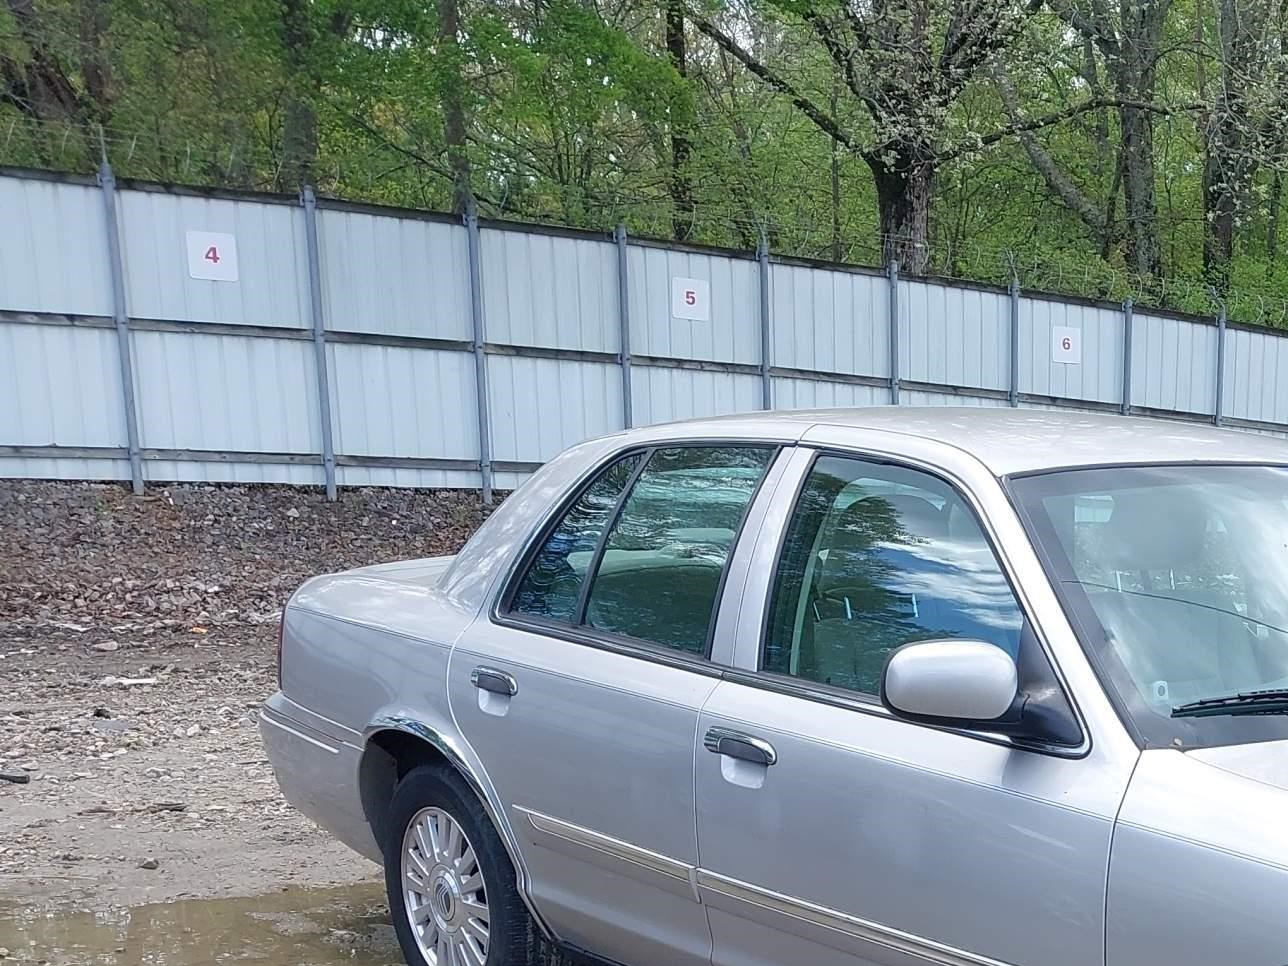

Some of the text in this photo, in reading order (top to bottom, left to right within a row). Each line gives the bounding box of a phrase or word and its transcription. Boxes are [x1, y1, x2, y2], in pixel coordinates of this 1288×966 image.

[205, 247, 220, 263] 4
[685, 291, 696, 305] 5
[1062, 337, 1071, 350] 6
